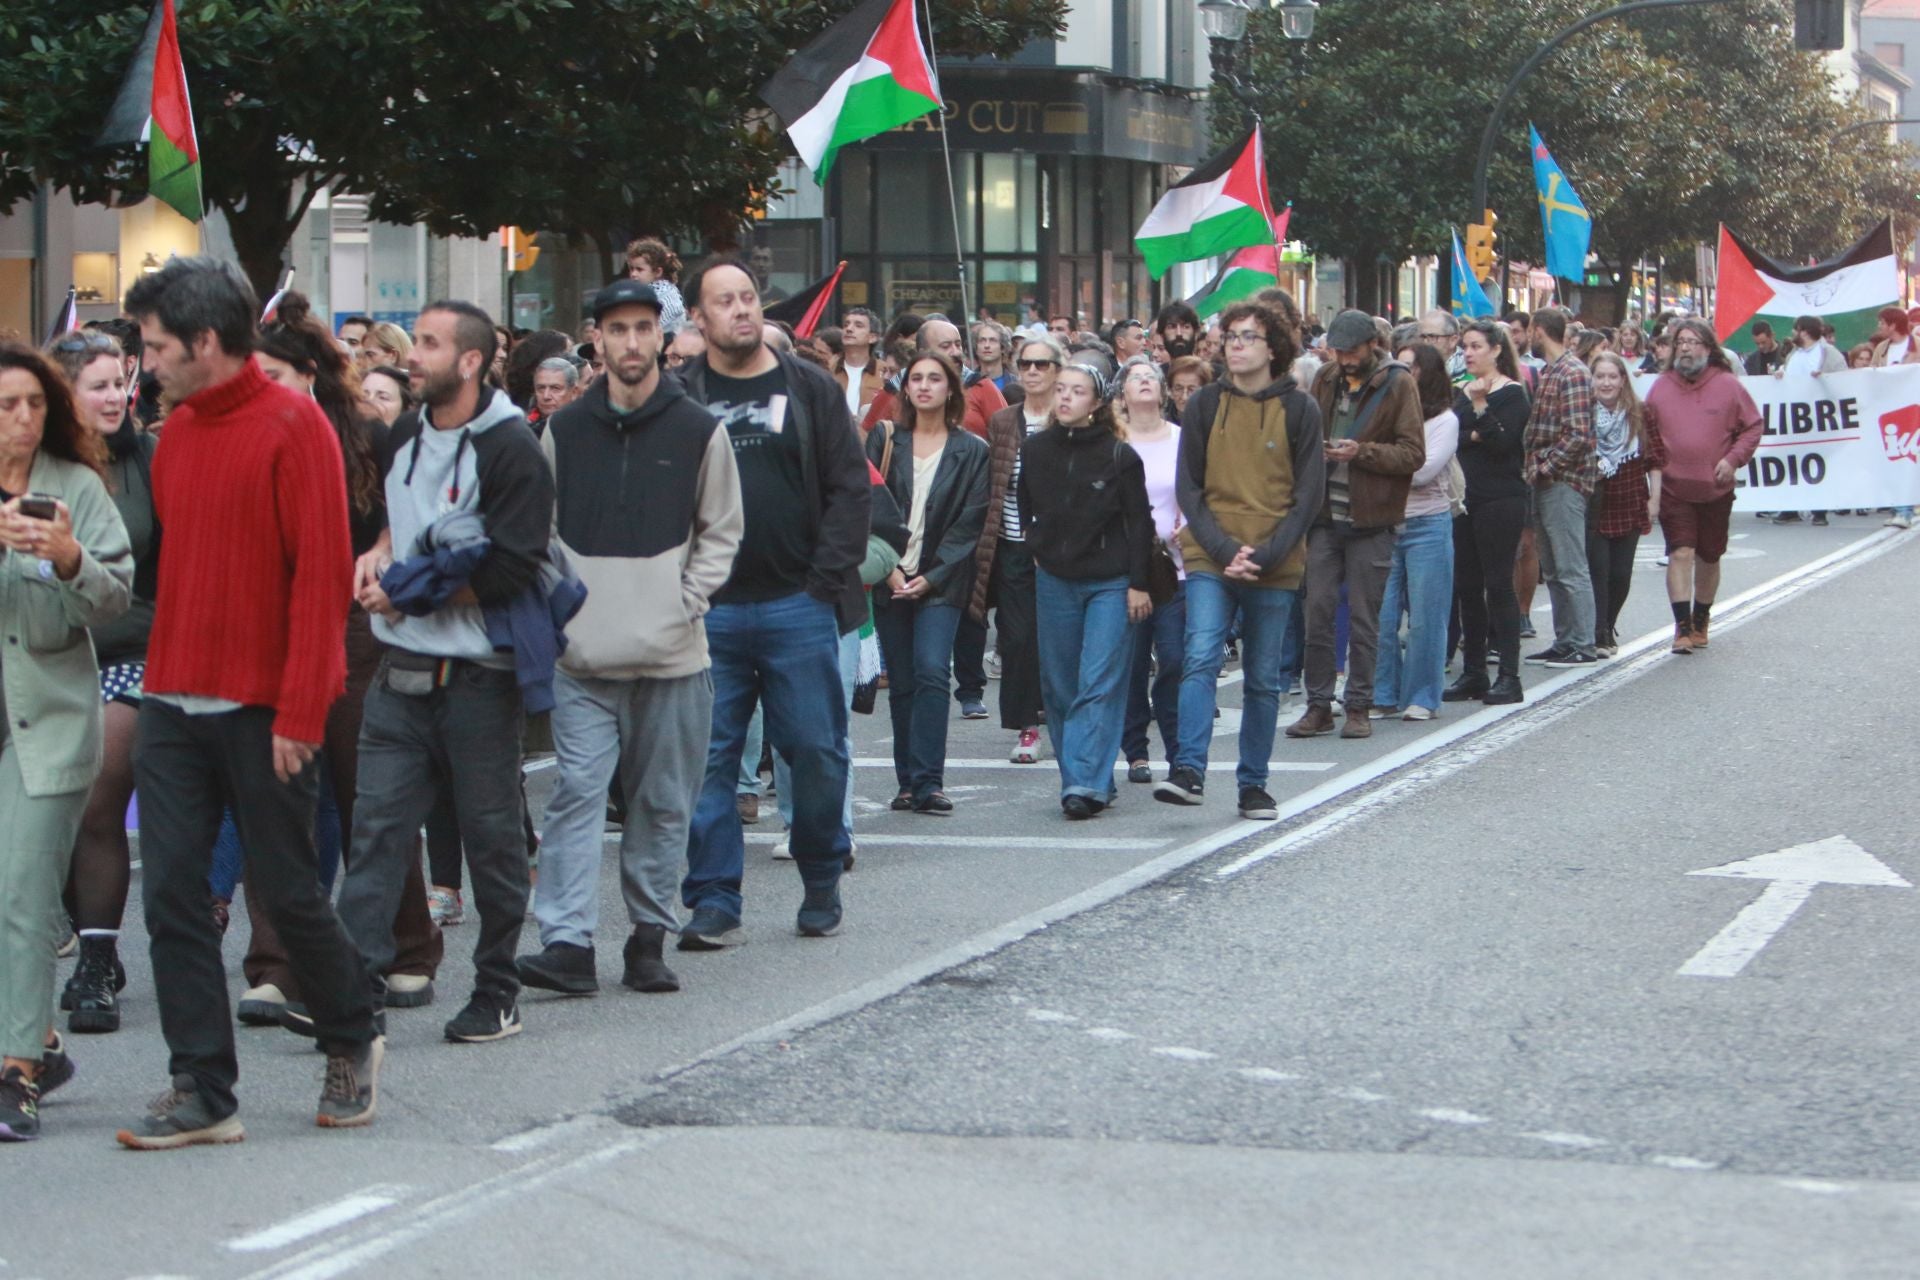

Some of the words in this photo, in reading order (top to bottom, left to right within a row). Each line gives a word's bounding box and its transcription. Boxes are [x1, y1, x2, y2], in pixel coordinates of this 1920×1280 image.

[968, 100, 1041, 133] CUT
[892, 288, 936, 300] CHEAP
[1762, 397, 1860, 436] LIBRE
[1735, 452, 1826, 488] IDIO
